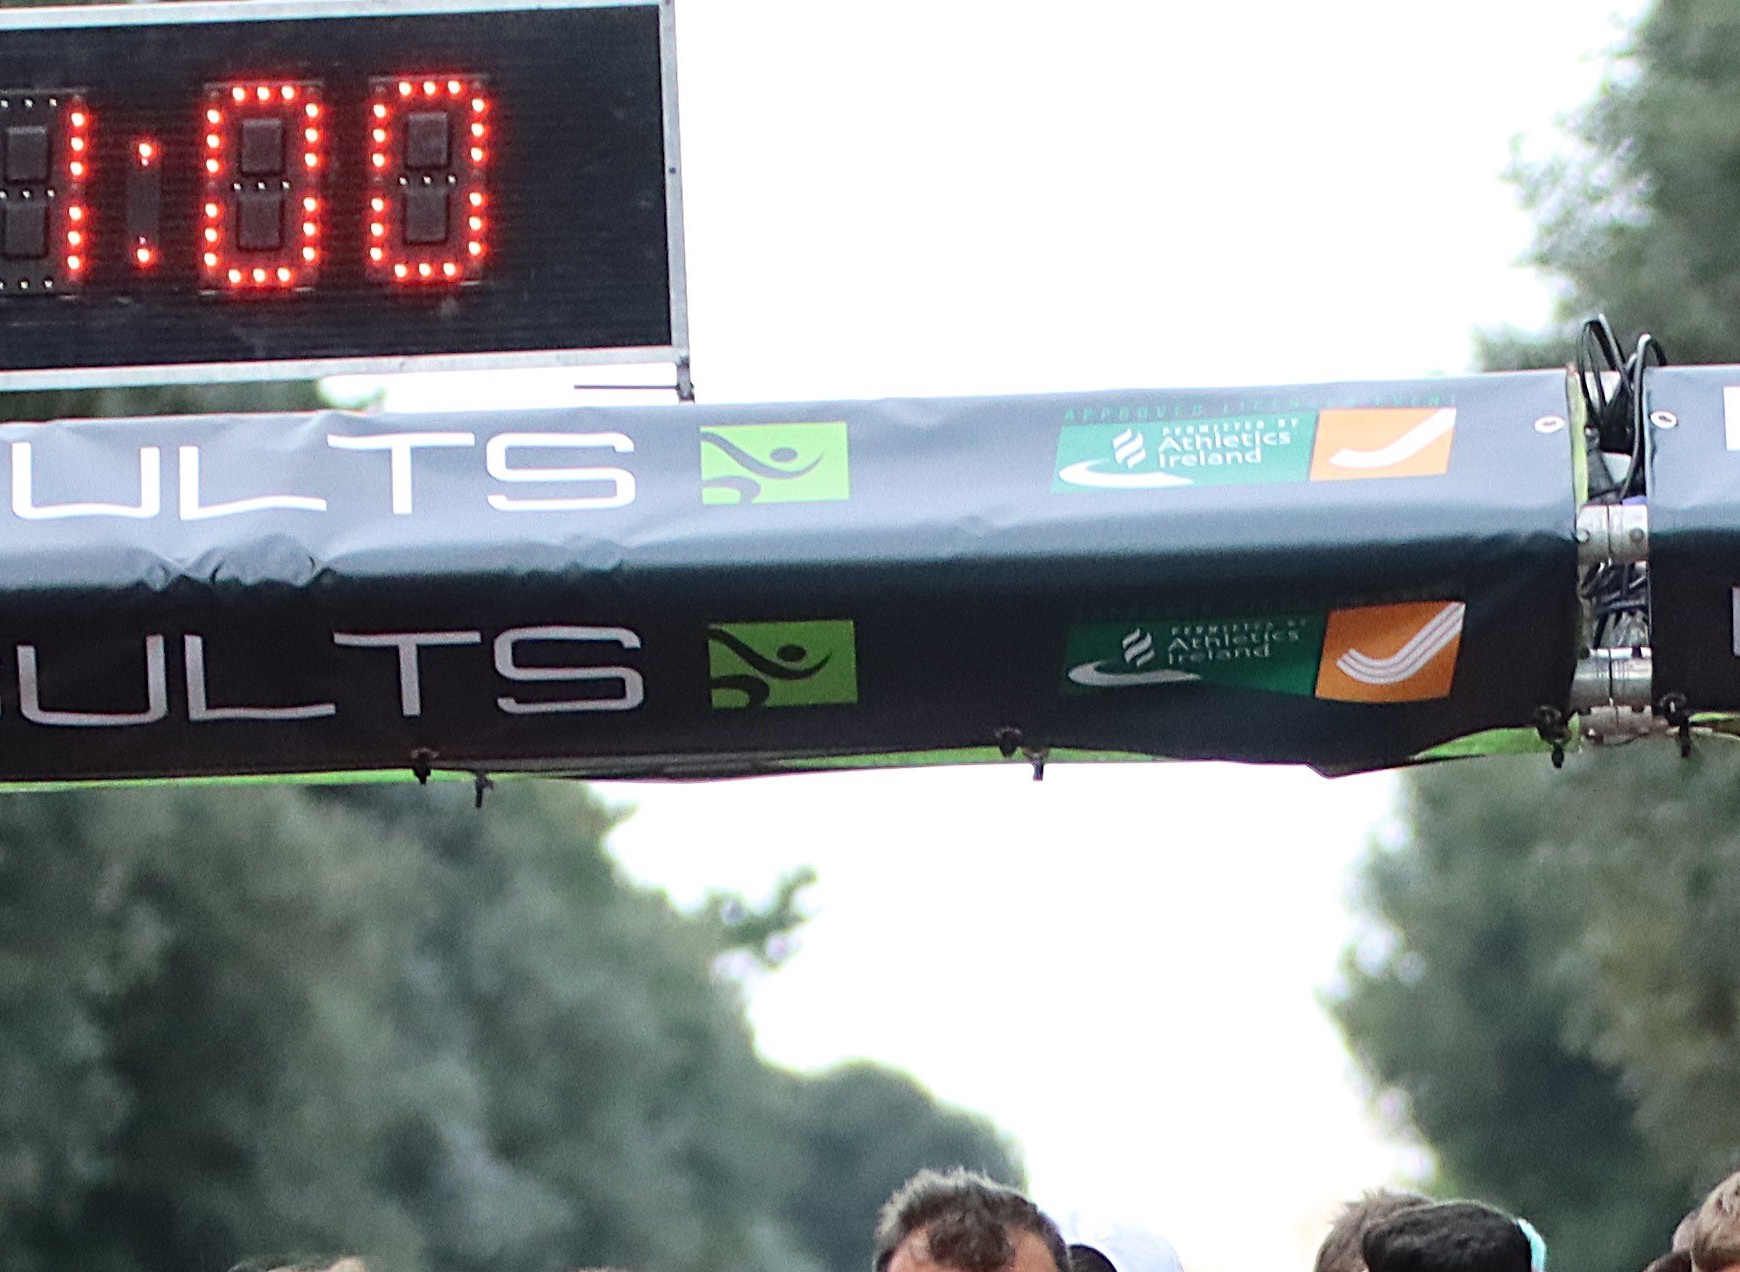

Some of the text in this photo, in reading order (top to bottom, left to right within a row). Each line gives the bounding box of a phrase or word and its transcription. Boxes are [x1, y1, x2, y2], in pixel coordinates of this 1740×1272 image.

[1158, 430, 1292, 452] Athletics
[1158, 447, 1263, 468] Ireland
[1166, 630, 1300, 652] Athletics
[1167, 644, 1271, 666] Ireland
